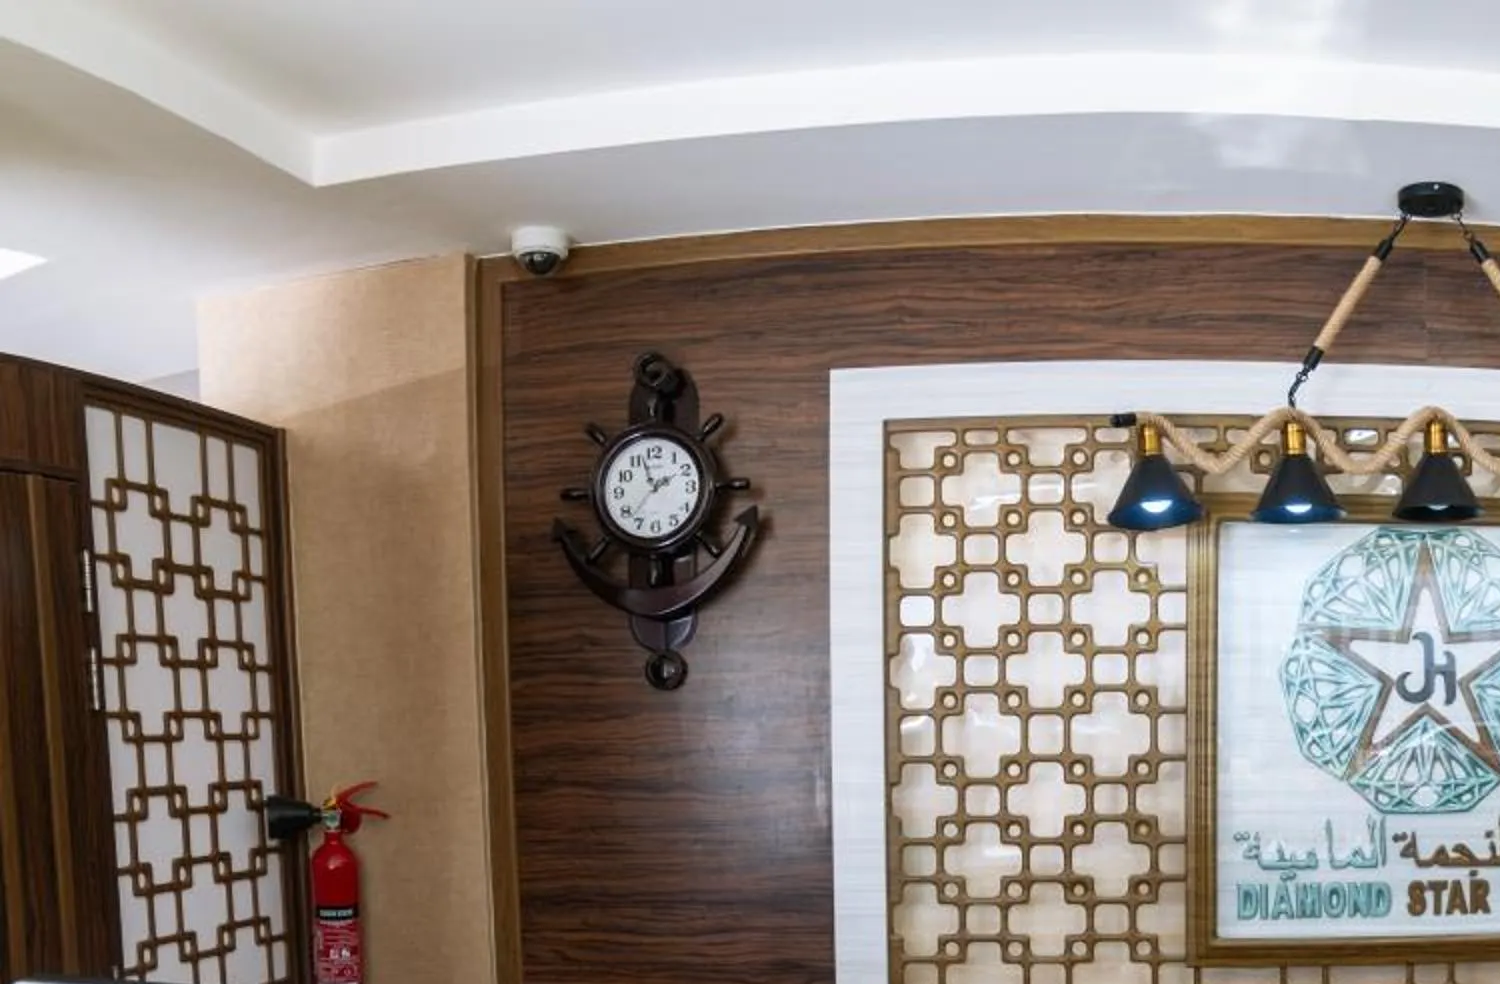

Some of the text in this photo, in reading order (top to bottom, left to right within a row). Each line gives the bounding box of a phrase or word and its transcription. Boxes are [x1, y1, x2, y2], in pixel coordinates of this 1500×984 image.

[647, 445, 662, 459] 12
[671, 452, 677, 464] 1
[630, 454, 641, 467] 11
[619, 469, 633, 482] 10
[680, 463, 691, 477] 2
[613, 486, 625, 499] 9
[685, 479, 697, 494] 3
[620, 504, 632, 518] 8
[633, 517, 644, 530] 7
[668, 514, 679, 527] 5
[1237, 880, 1393, 920] DIAMOND
[1407, 878, 1491, 917] STAR
